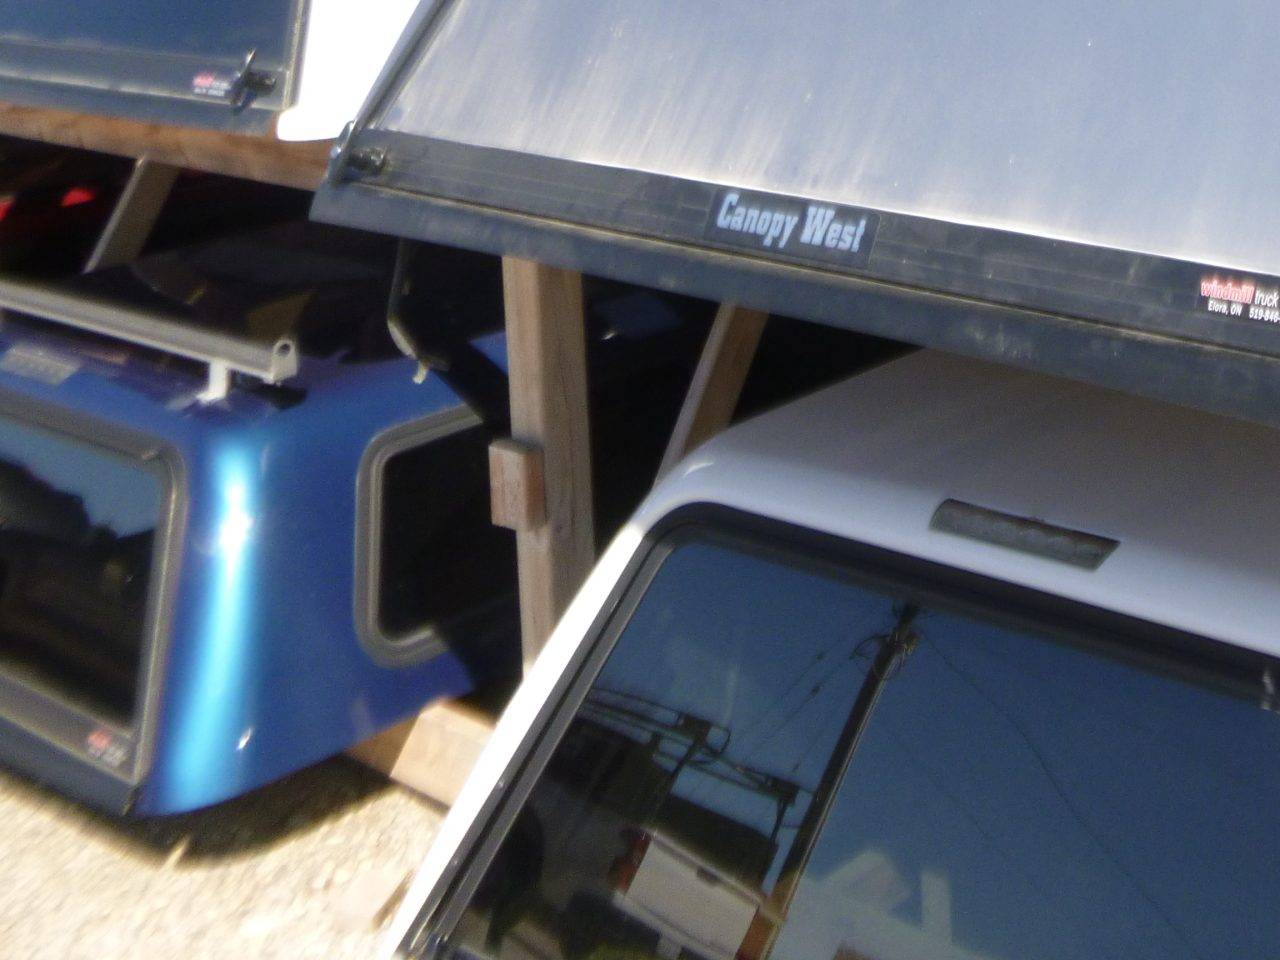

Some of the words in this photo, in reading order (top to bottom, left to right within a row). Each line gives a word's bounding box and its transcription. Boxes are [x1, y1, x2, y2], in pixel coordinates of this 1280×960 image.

[717, 193, 798, 248] Canopy
[801, 205, 867, 253] West
[1254, 288, 1280, 308] truck
[1230, 303, 1243, 316] ON
